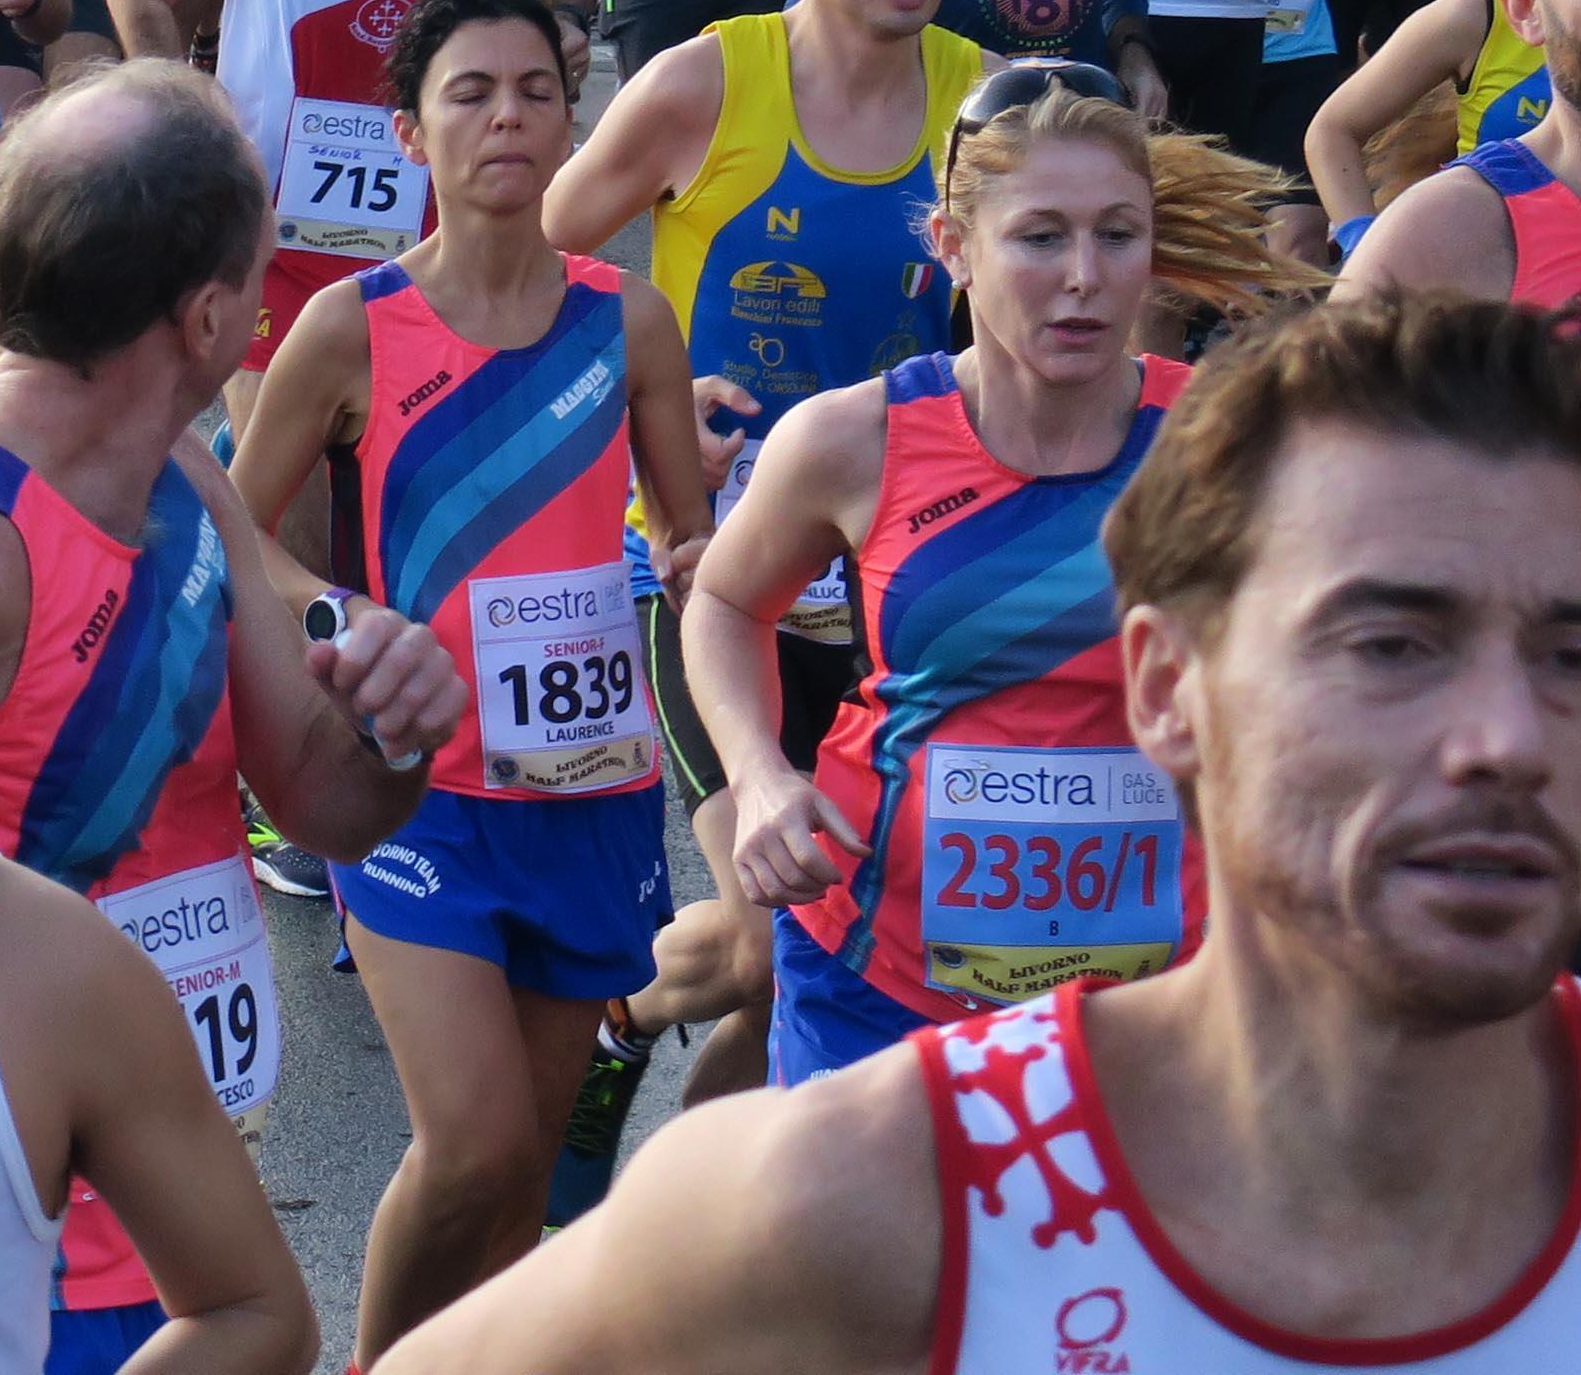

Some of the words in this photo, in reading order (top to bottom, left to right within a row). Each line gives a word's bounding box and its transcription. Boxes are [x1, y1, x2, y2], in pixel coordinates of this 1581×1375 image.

[324, 114, 385, 141] estra
[310, 160, 400, 213] 715
[767, 205, 800, 235] N
[734, 293, 781, 311] Lavori
[785, 299, 821, 314] edili
[396, 369, 453, 418] Joma
[906, 486, 980, 534] Joma
[517, 585, 598, 622] estra
[71, 589, 119, 663] Joma
[544, 638, 605, 658] SENIOR-F
[498, 649, 634, 727] 1839
[545, 721, 615, 744] LAURENCE
[526, 770, 566, 787] HALF
[569, 757, 627, 784] MARATHON
[556, 746, 608, 773] LIVORNO
[981, 767, 1097, 806] estra
[1122, 773, 1156, 789] GAS
[1122, 788, 1167, 805] LUCE
[362, 861, 427, 899] RUNNING
[415, 854, 442, 895] TEAM
[936, 831, 1159, 913] 2336/1
[142, 896, 229, 953] estra
[1048, 920, 1059, 937] B
[971, 968, 1022, 995] HALF
[1025, 968, 1124, 993] MARATHON
[1008, 952, 1091, 980] LIVORNO
[179, 982, 258, 1084] 19
